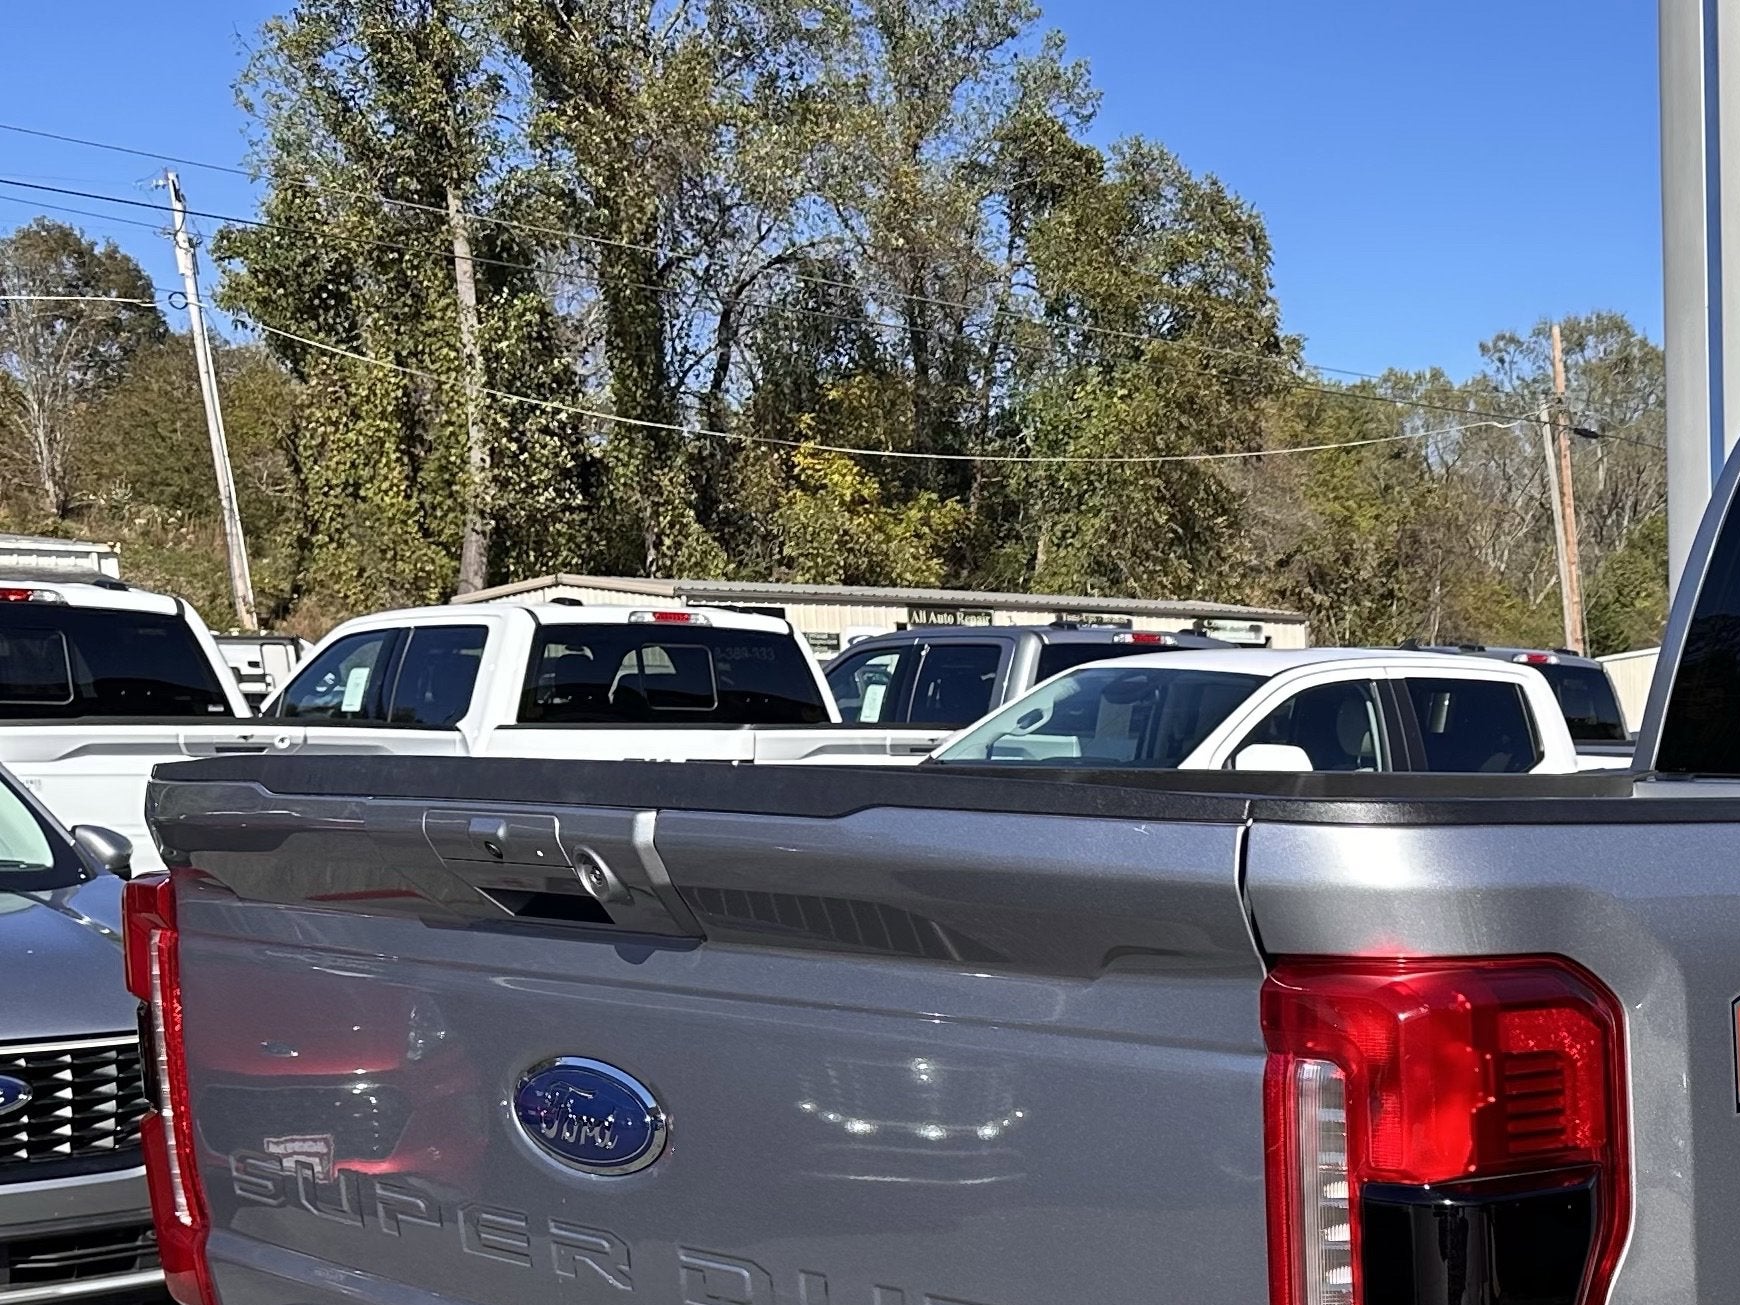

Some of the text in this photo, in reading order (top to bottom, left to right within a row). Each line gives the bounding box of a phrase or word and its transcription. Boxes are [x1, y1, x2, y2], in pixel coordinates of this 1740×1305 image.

[911, 610, 990, 626] All Auto Repair
[540, 1080, 620, 1150] Ford
[229, 1148, 635, 1292] SUPER
